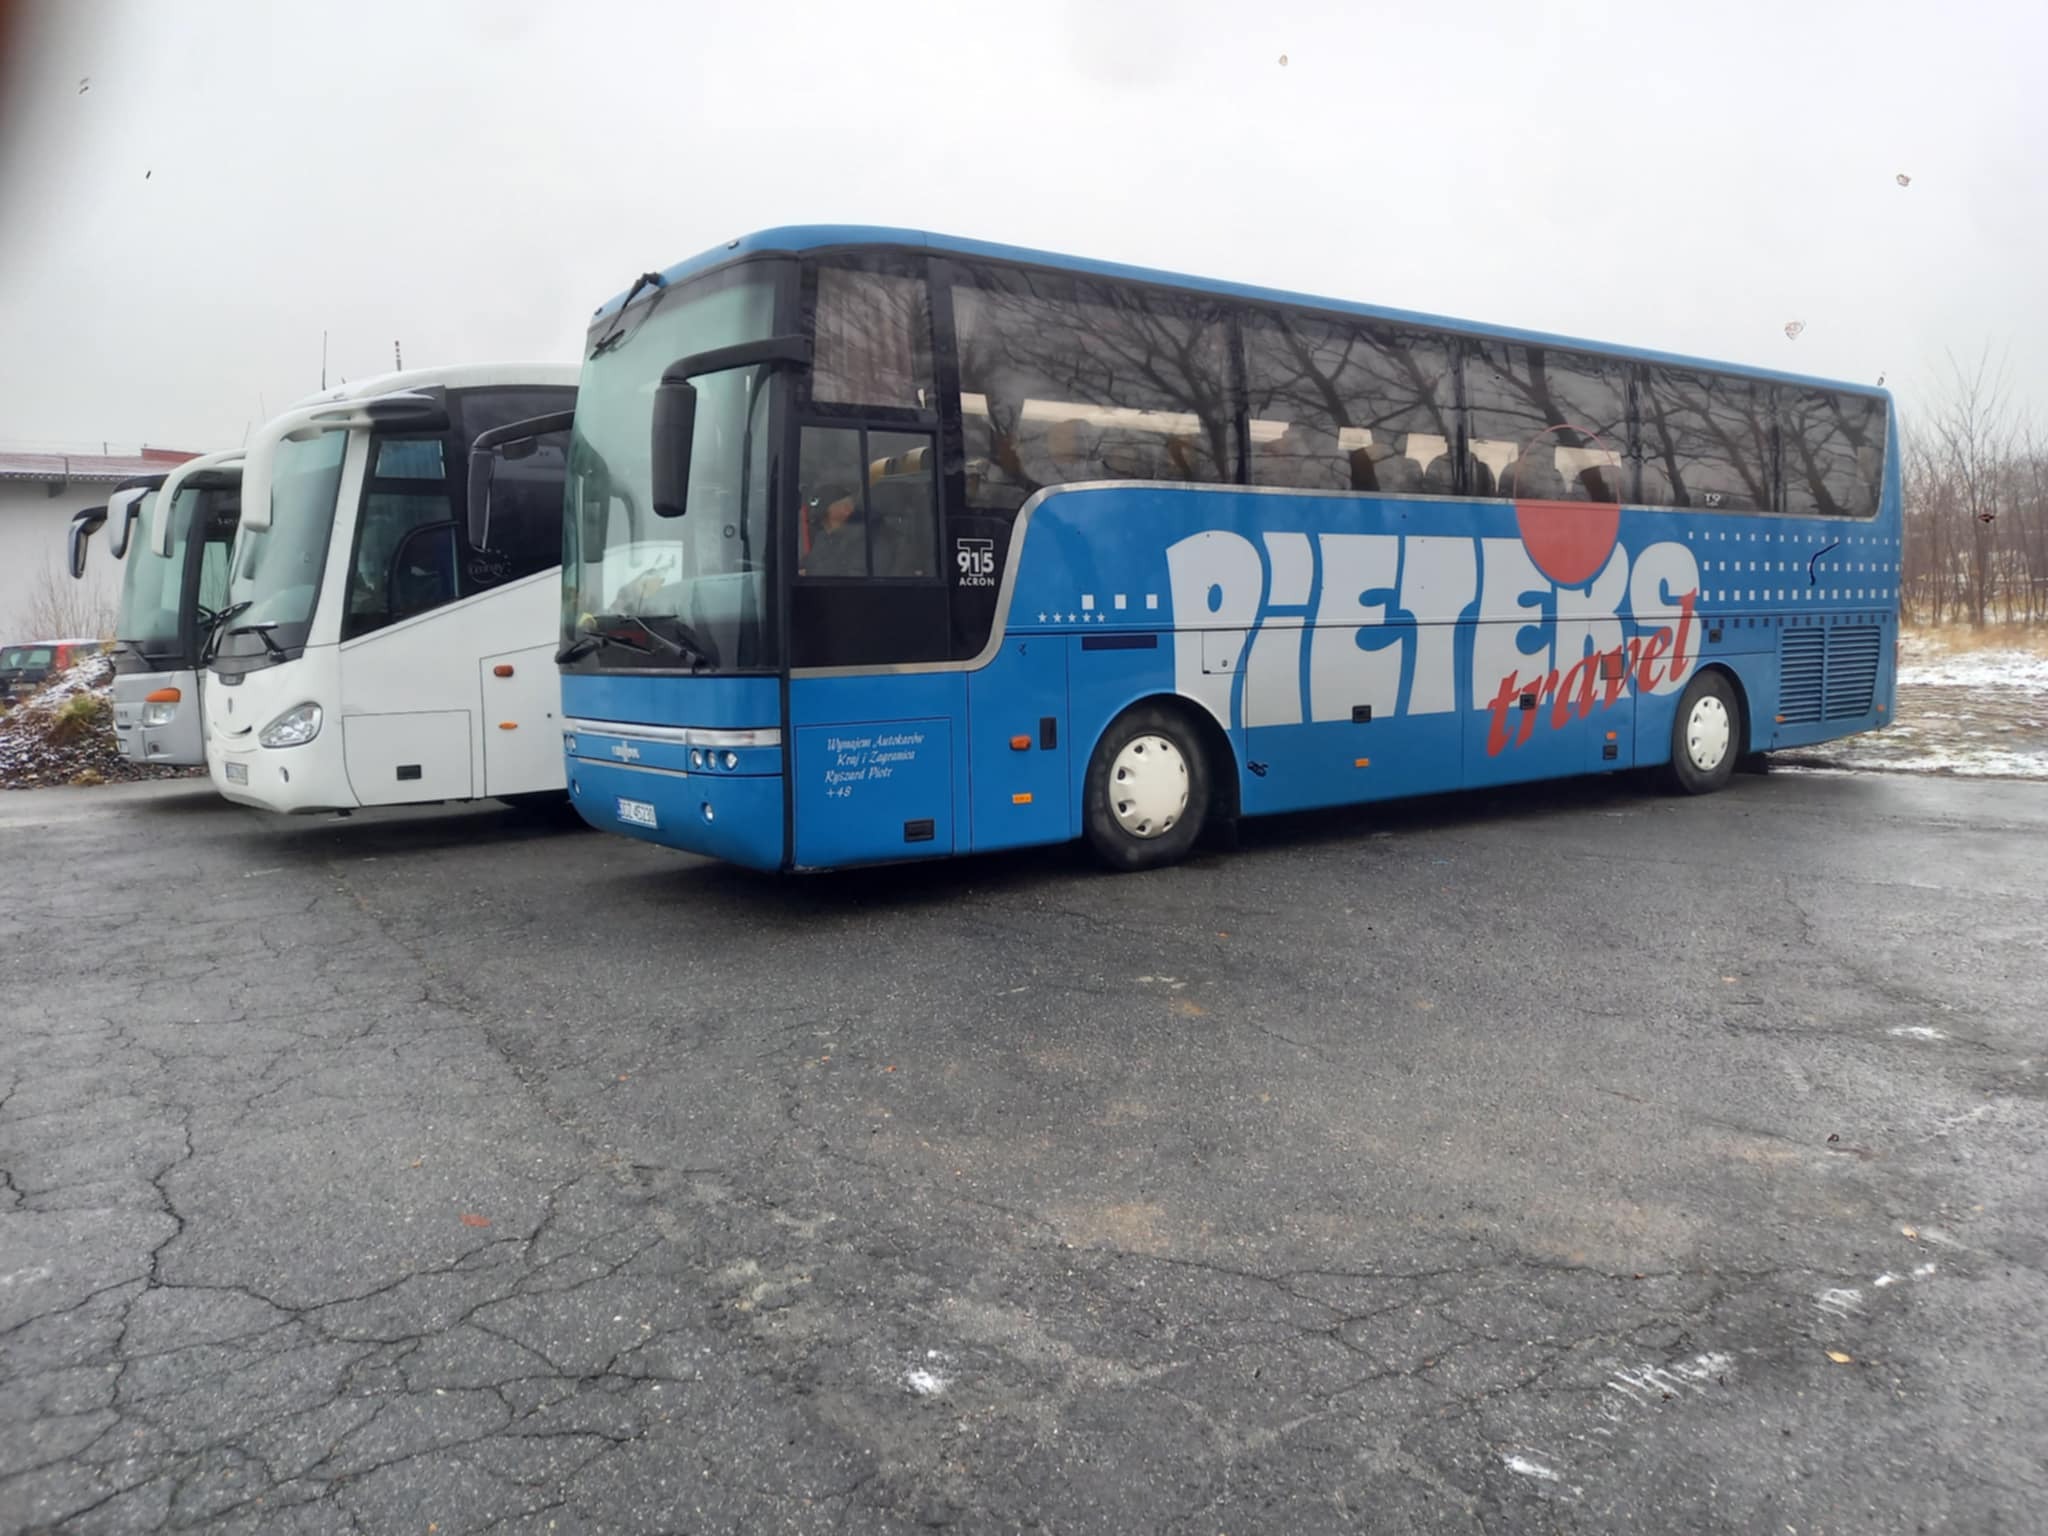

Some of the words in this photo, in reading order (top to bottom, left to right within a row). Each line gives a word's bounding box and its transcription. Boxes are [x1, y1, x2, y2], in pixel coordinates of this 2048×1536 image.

[957, 551, 994, 573] 915
[959, 576, 995, 587] ACRON
[1486, 587, 1699, 758] travel
[826, 737, 873, 753] Wynajem
[873, 732, 925, 748] Autokarów
[837, 752, 860, 767] Kraj
[861, 752, 868, 764] i
[868, 749, 916, 765] Zagranica
[825, 768, 866, 785] Ryszard
[868, 765, 893, 780] Piotr
